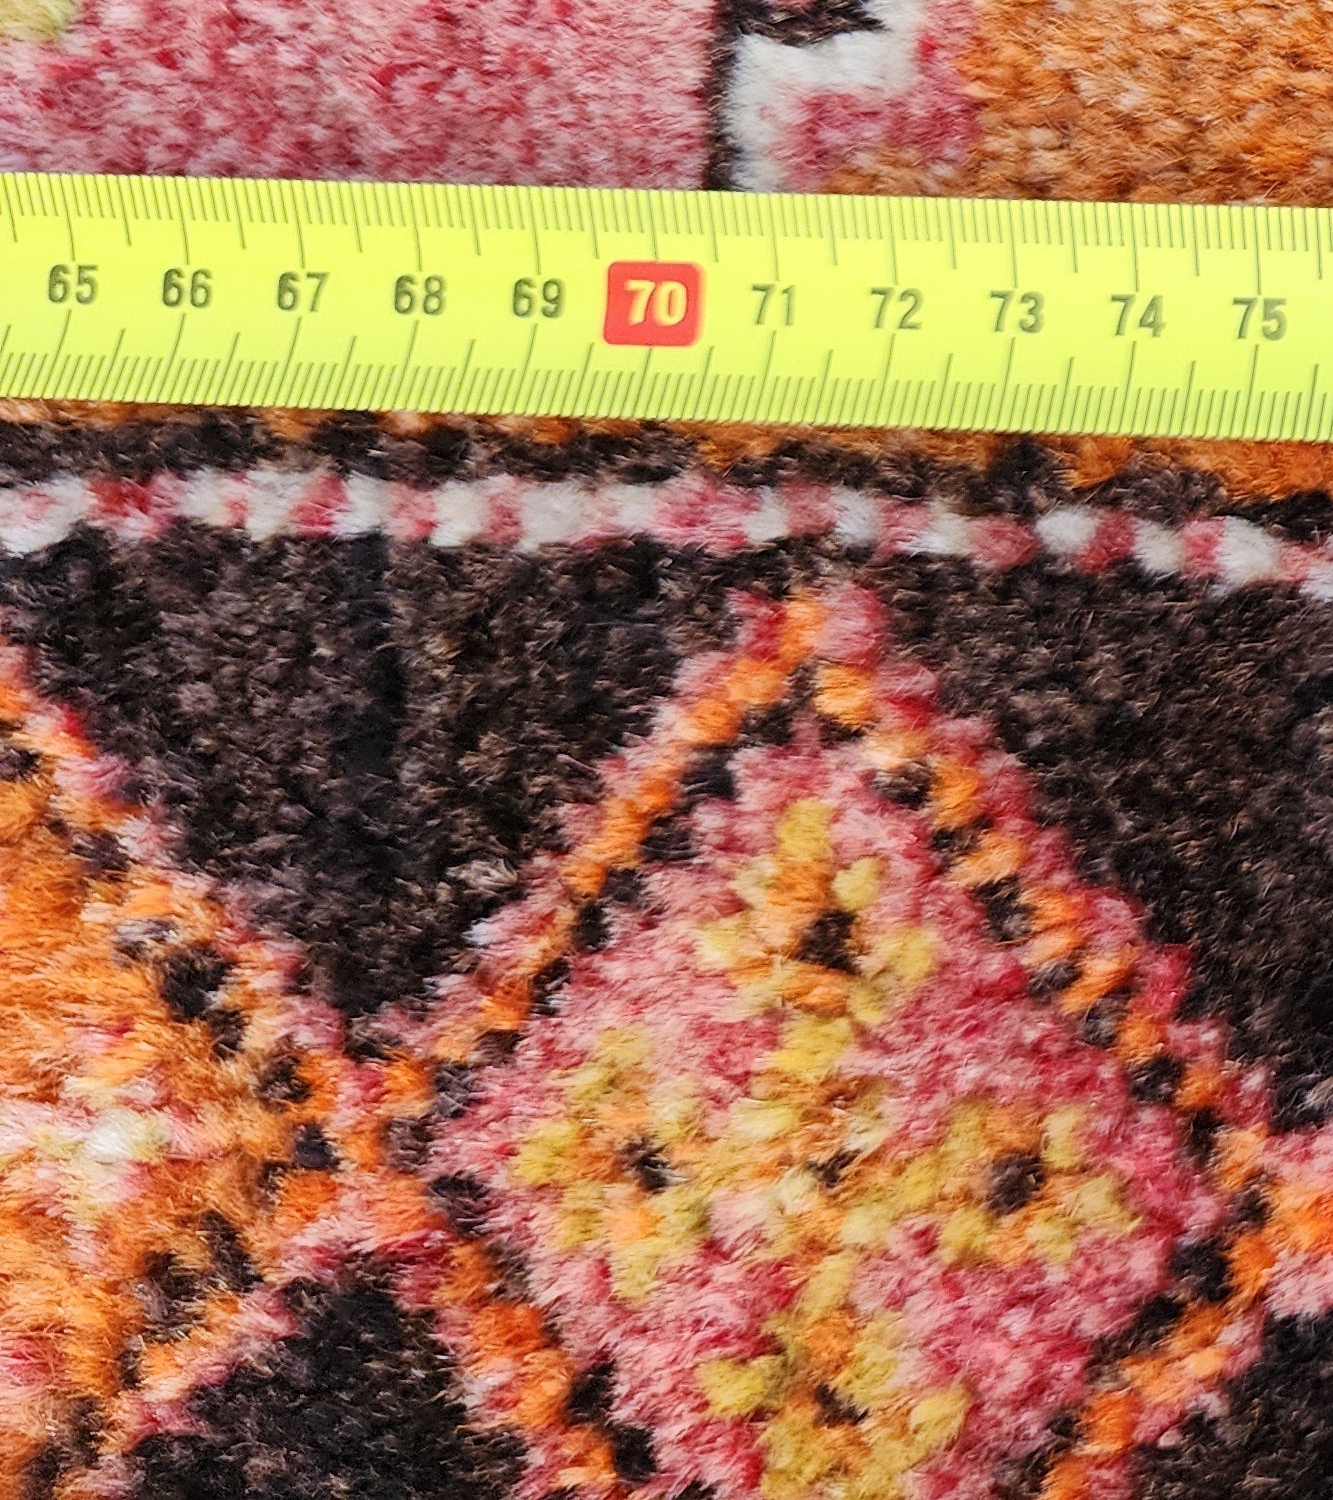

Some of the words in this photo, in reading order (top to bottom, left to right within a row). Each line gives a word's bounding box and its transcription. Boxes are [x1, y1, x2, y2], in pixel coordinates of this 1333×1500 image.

[48, 264, 99, 305] 65
[161, 268, 214, 309] 66
[276, 271, 330, 313] 67
[393, 274, 448, 316] 68
[511, 278, 566, 320] 69
[624, 279, 688, 328] 70
[751, 284, 796, 326] 71
[870, 287, 924, 330] 72
[990, 291, 1046, 334] 73
[1111, 294, 1166, 338] 74
[1232, 298, 1288, 341] 75
